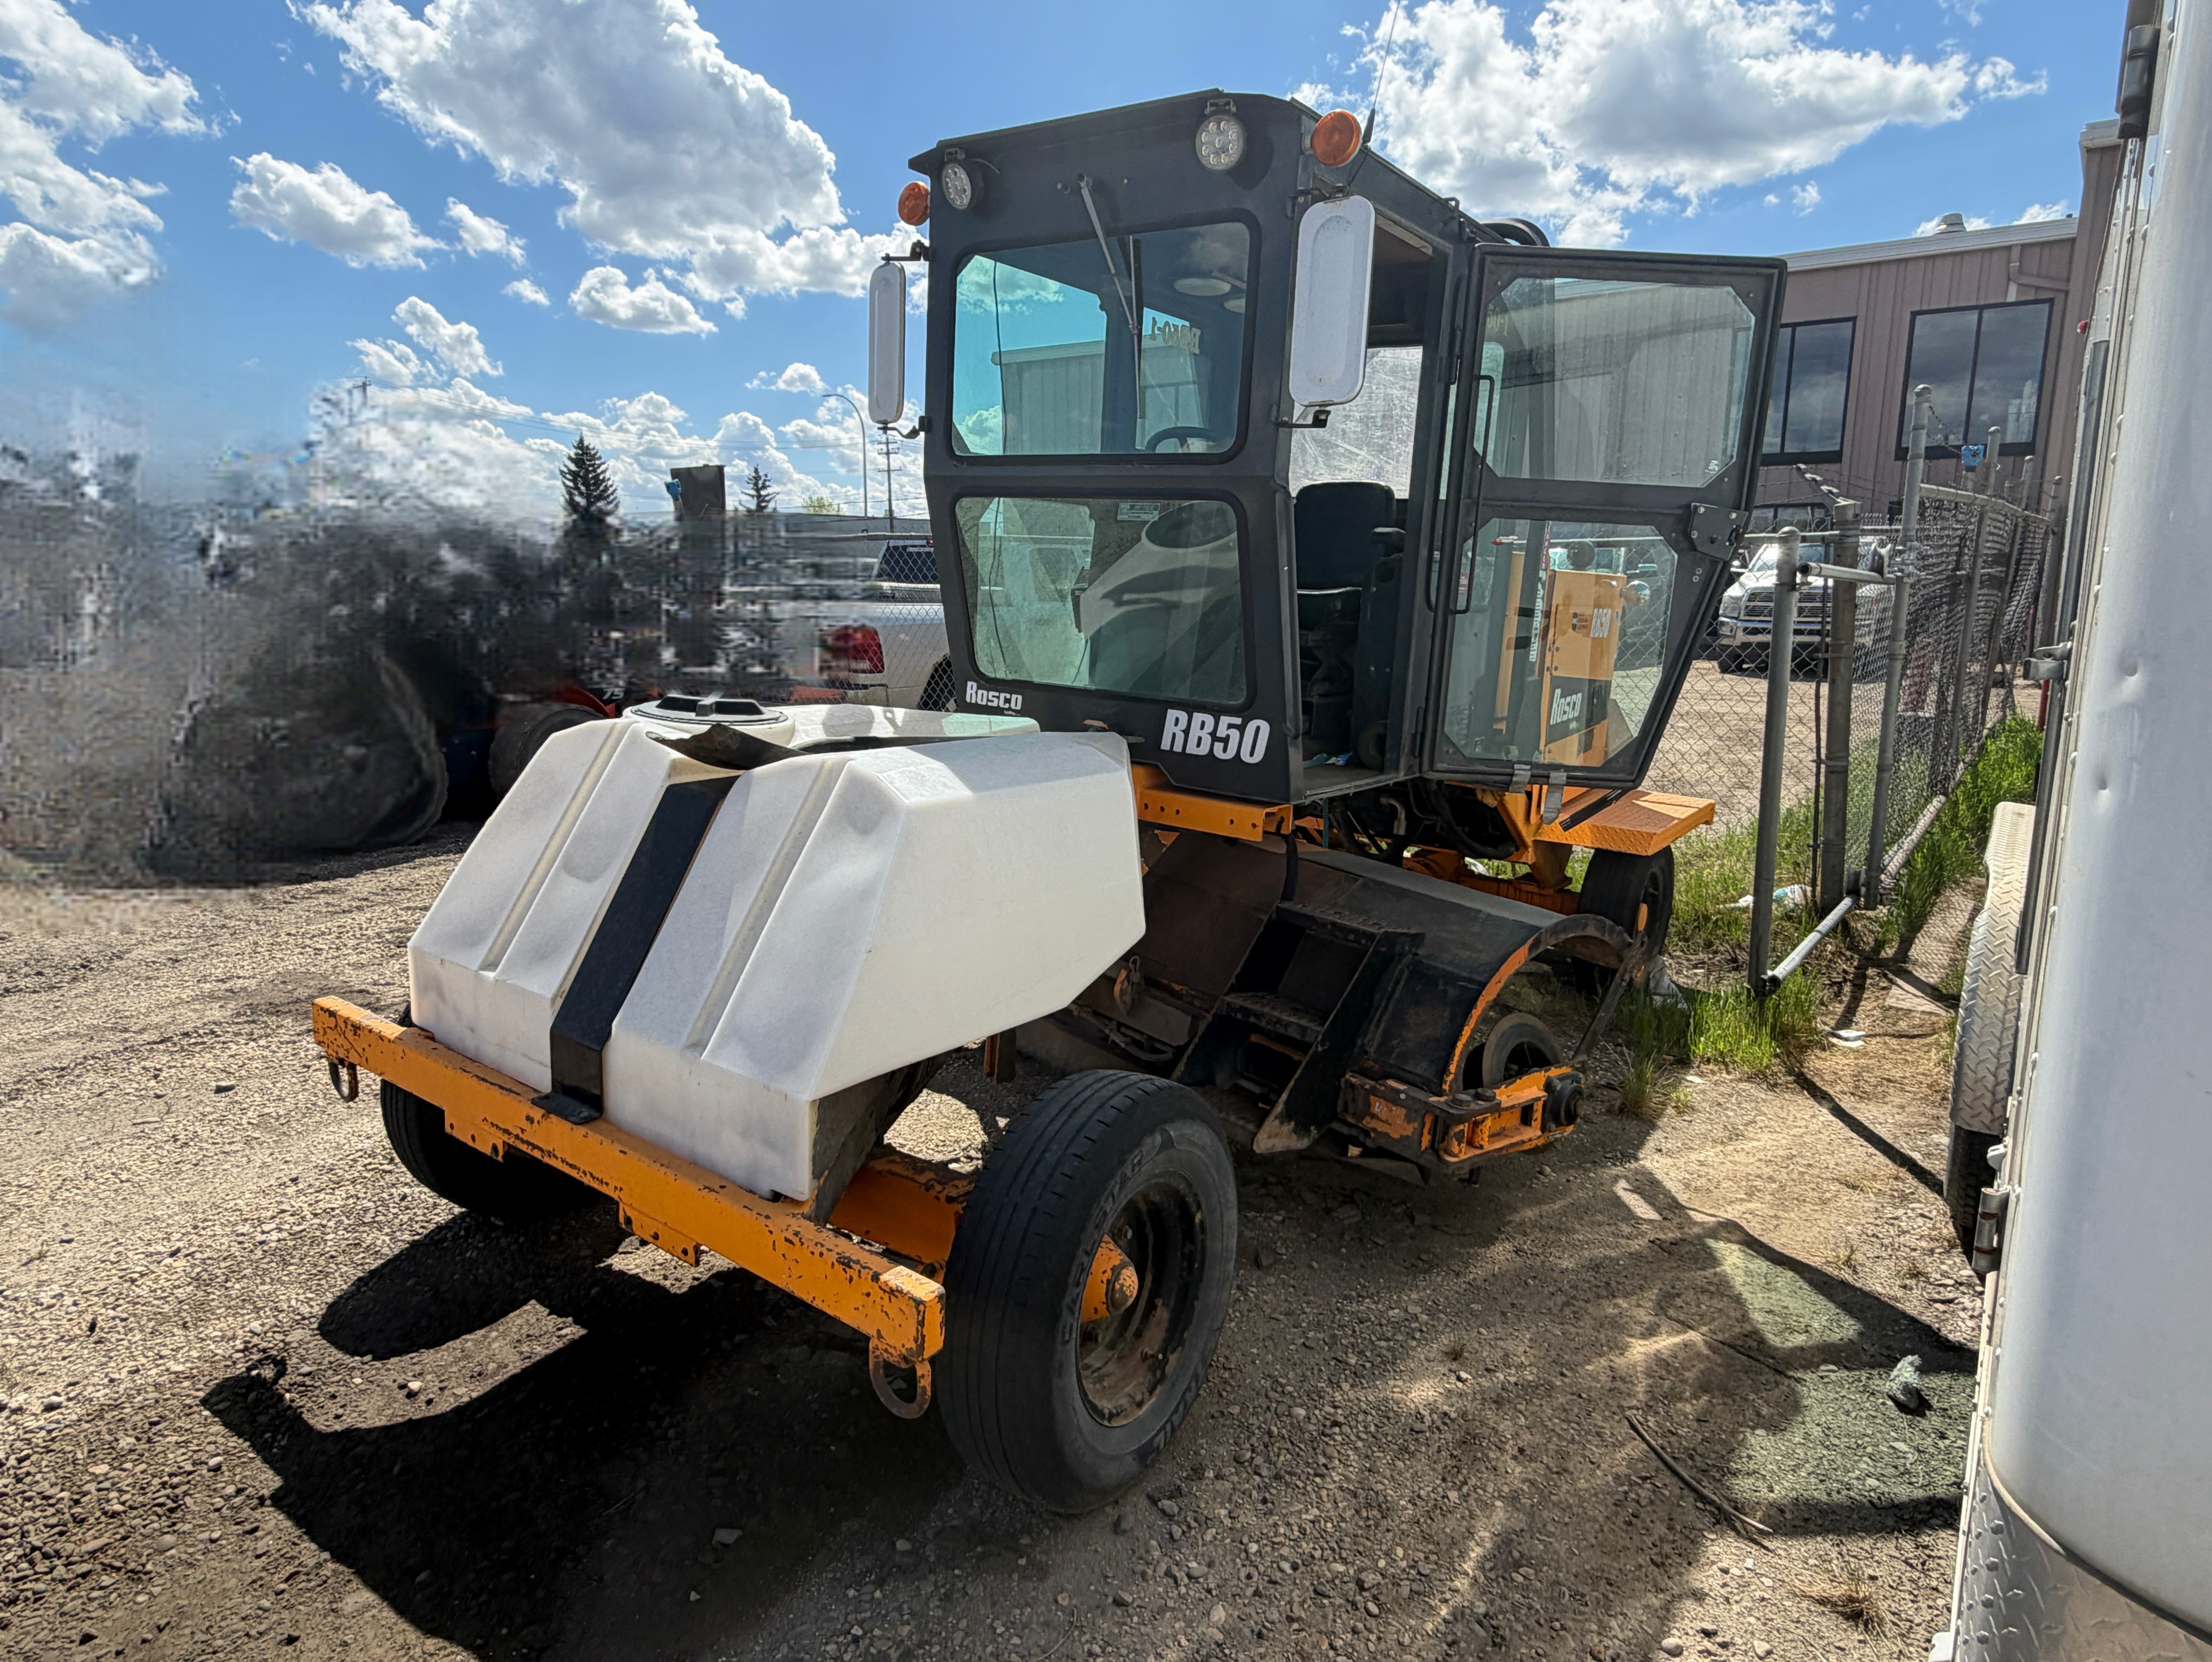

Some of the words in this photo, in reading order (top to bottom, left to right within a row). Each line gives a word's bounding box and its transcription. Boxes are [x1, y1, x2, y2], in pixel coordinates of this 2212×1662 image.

[603, 688, 625, 700] 75
[966, 681, 1022, 710] Rosco
[1550, 688, 1582, 725] Rosco
[1161, 709, 1270, 763] RB50
